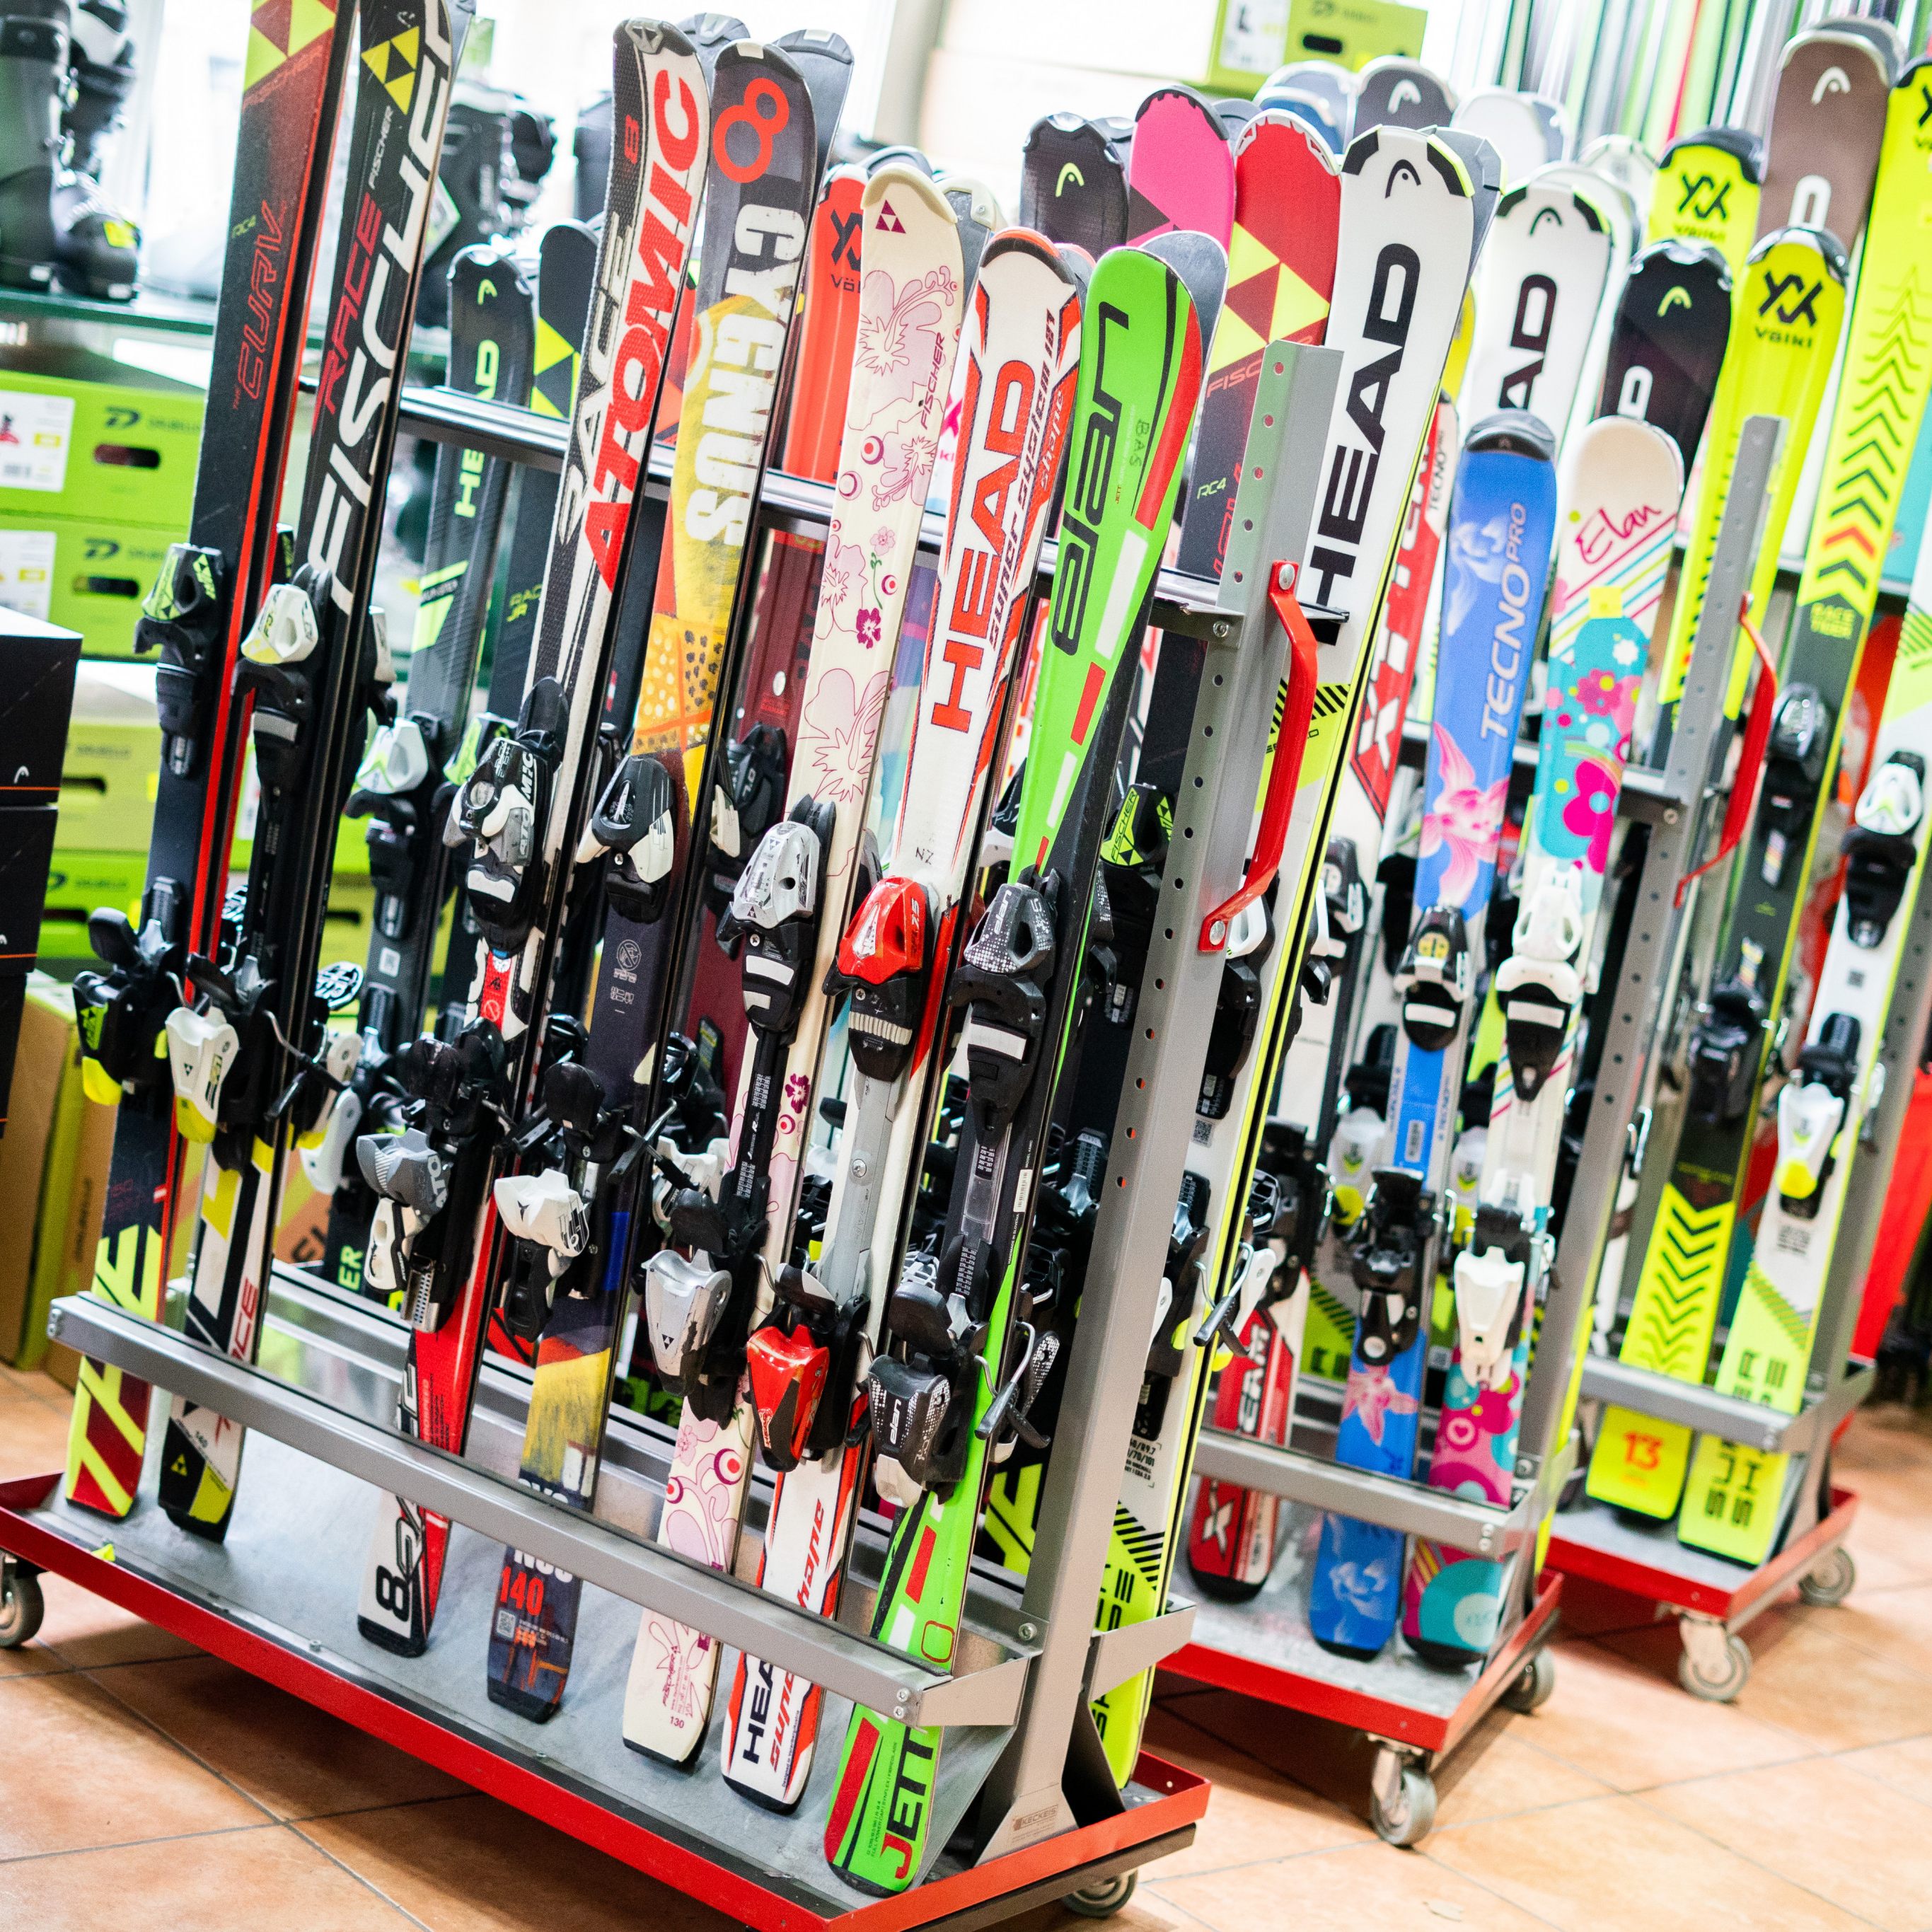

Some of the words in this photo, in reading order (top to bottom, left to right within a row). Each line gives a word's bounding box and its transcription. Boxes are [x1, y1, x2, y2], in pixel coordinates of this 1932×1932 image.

[369, 105, 395, 190] FISCHER
[237, 199, 287, 400] CURV
[311, 192, 383, 436] RACE
[585, 69, 700, 594] ATOMIC
[453, 338, 500, 519] HED
[683, 204, 808, 547] CYGNUS
[921, 331, 944, 430] FISCHER
[1206, 359, 1262, 399] FISC
[1051, 301, 1130, 656] elan
[1196, 478, 1227, 499] RC4
[1300, 243, 1421, 647] HEAD
[931, 359, 1036, 734] HEAD
[1575, 503, 1662, 565] Elan
[1111, 791, 1138, 862] FISCHER
[994, 889, 1012, 935] elan
[890, 1398, 902, 1445] elan
[499, 1565, 545, 1616] 140
[797, 1498, 824, 1609] hape
[669, 1715, 685, 1729] 130
[742, 1658, 774, 1765] HEA
[880, 1726, 935, 1880] JETT
